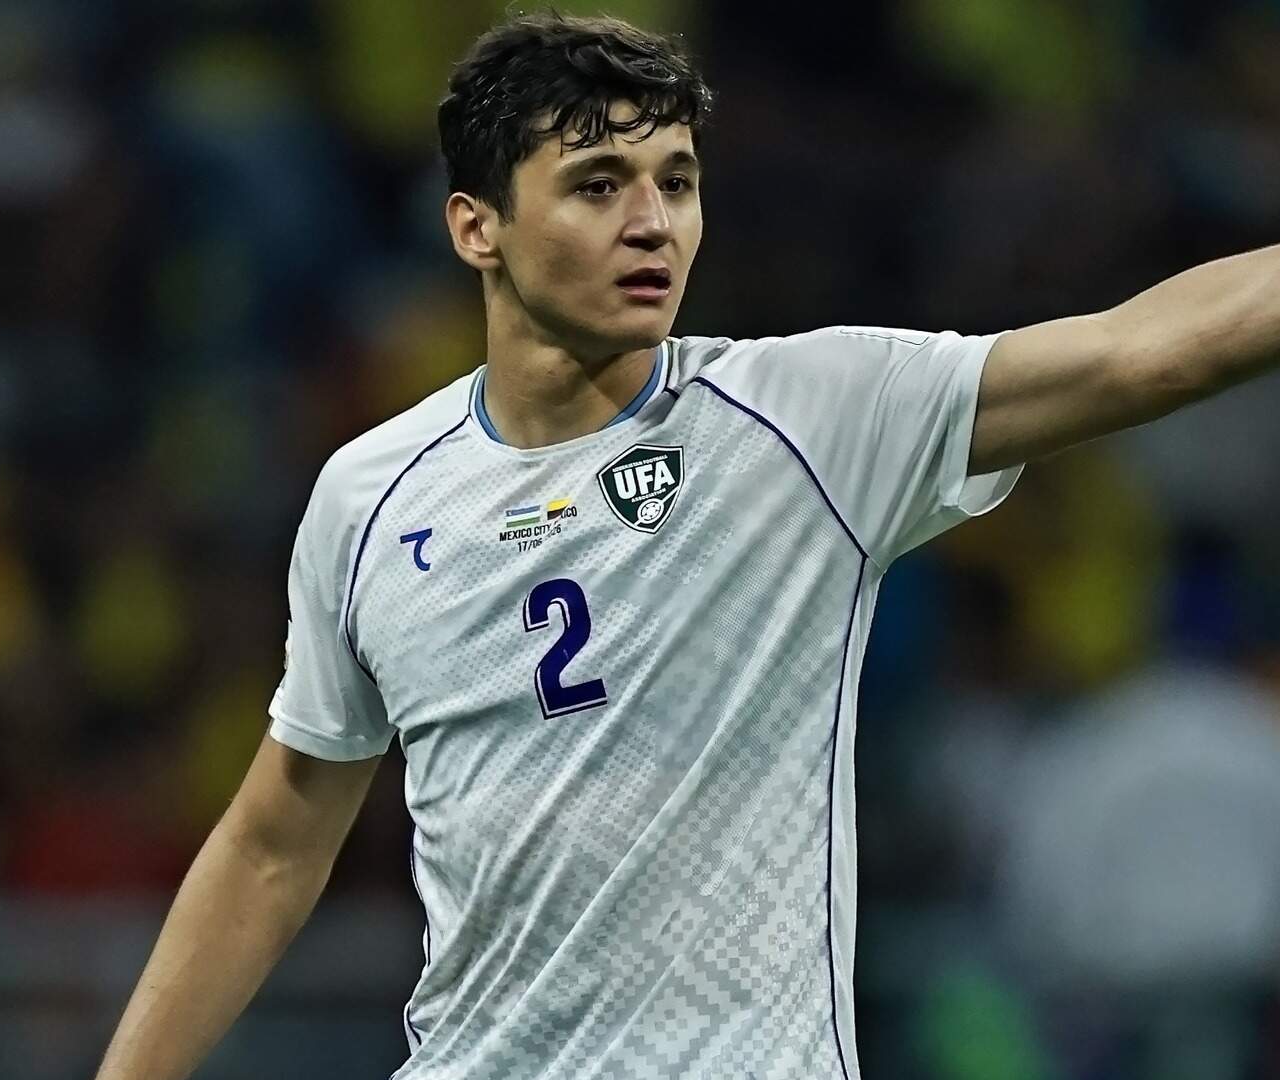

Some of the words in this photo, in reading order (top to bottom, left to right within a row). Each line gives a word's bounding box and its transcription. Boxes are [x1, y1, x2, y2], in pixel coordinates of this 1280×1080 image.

[613, 460, 676, 500] UFA
[499, 527, 532, 542] MEXICO
[522, 578, 608, 720] 2
